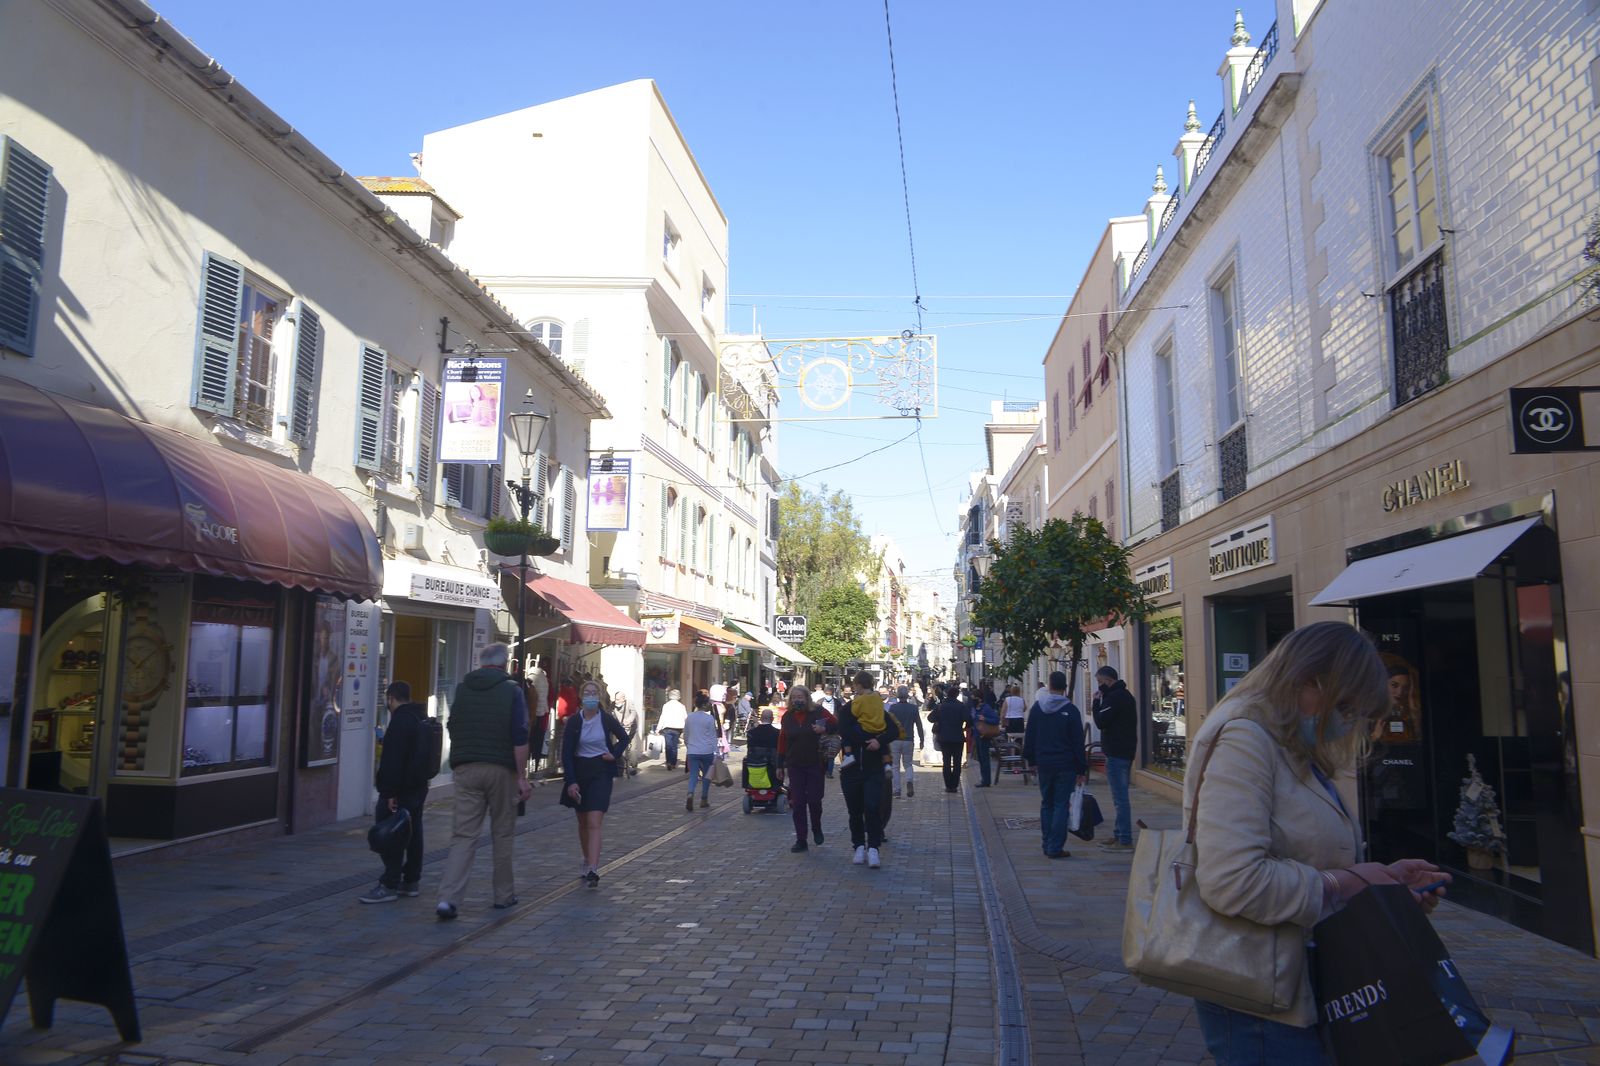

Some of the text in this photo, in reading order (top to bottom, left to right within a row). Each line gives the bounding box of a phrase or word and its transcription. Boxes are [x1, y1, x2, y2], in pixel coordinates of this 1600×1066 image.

[447, 360, 502, 369] Richardsons
[1383, 459, 1470, 513] CHANEL
[186, 503, 238, 545] TAGORE
[1209, 537, 1270, 576] BEAUTIQUE
[425, 578, 491, 599] BUREAU DE CHANGE
[350, 610, 369, 618] BUREAU
[350, 628, 368, 636] CHANGE
[14, 854, 38, 867] our
[1324, 979, 1388, 1022] TRENDS
